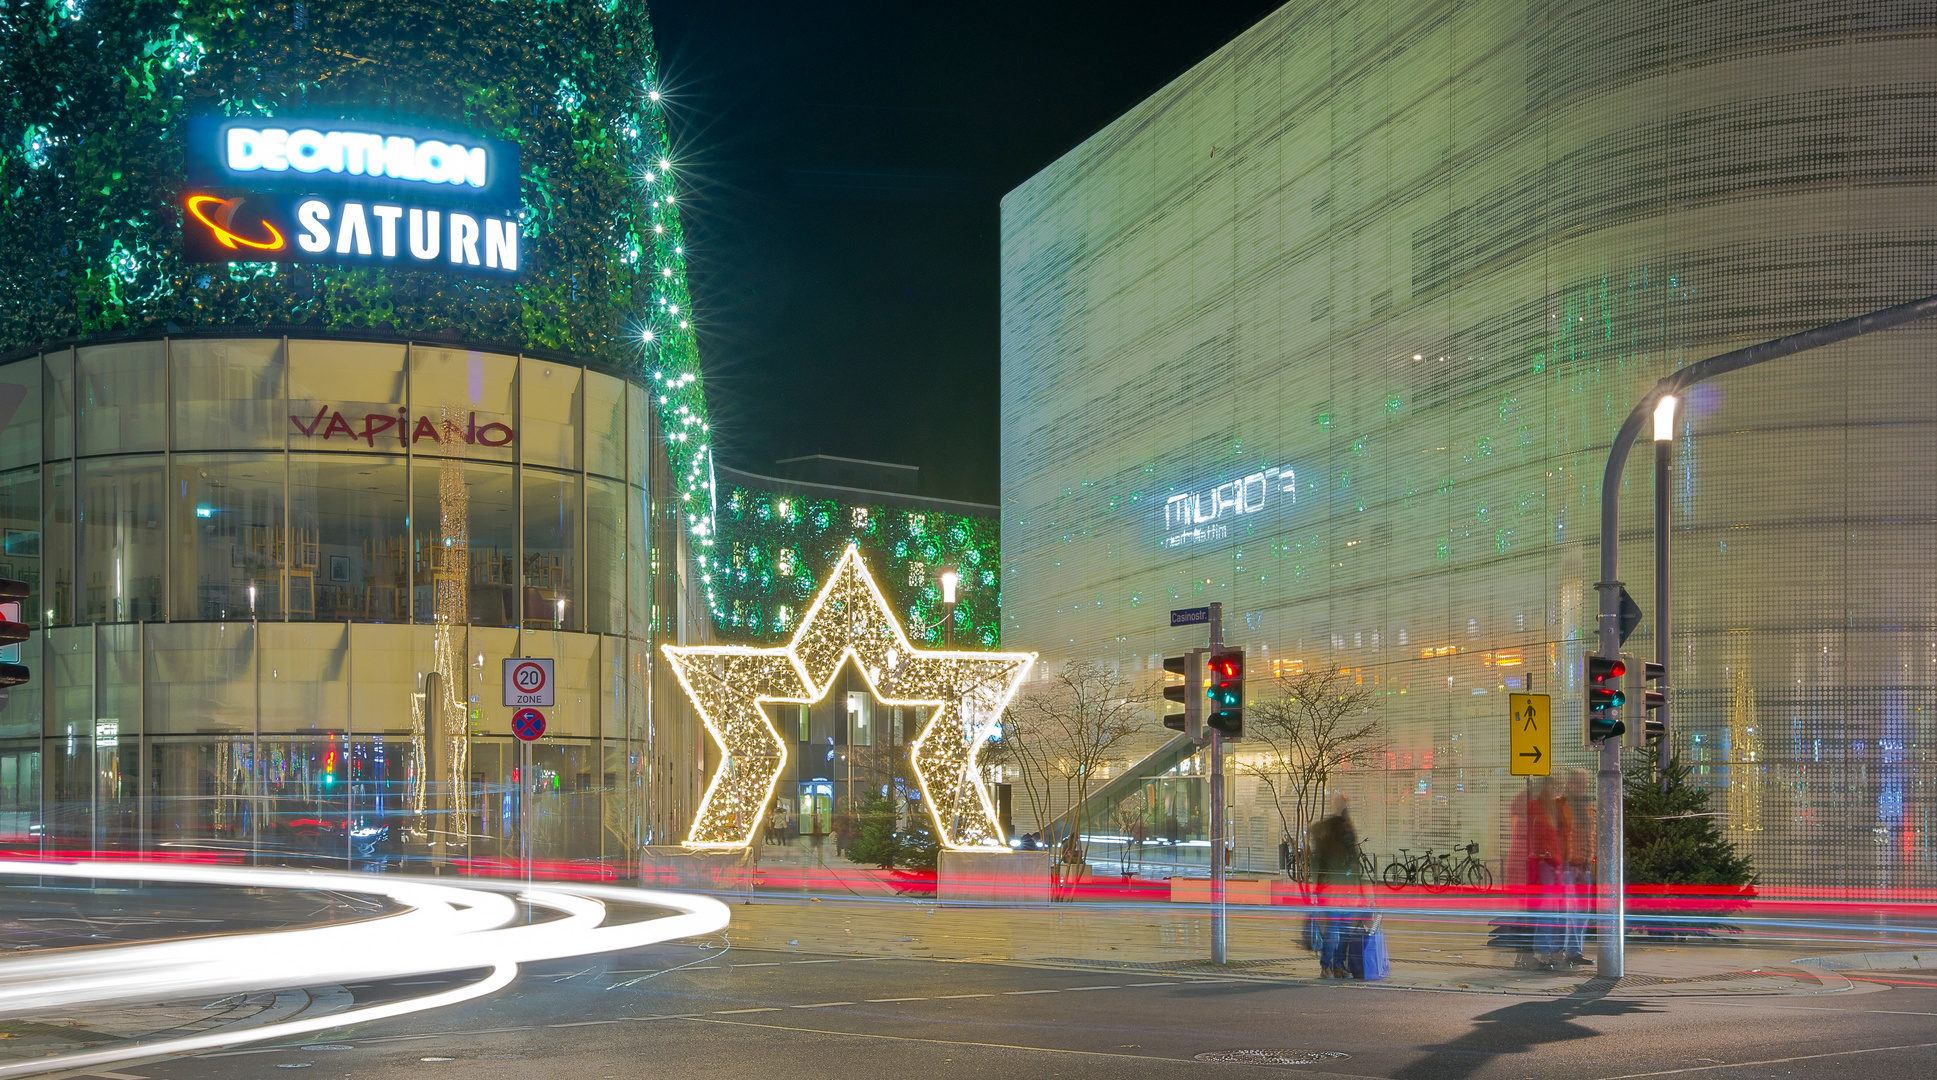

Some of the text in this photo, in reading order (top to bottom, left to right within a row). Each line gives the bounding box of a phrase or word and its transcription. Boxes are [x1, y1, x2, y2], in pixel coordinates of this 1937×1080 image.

[228, 127, 486, 187] DECATHLON
[298, 200, 518, 271] SATURN
[1171, 610, 1207, 623] Casinostr.
[519, 670, 539, 686] 20
[516, 695, 542, 704] ZONE
